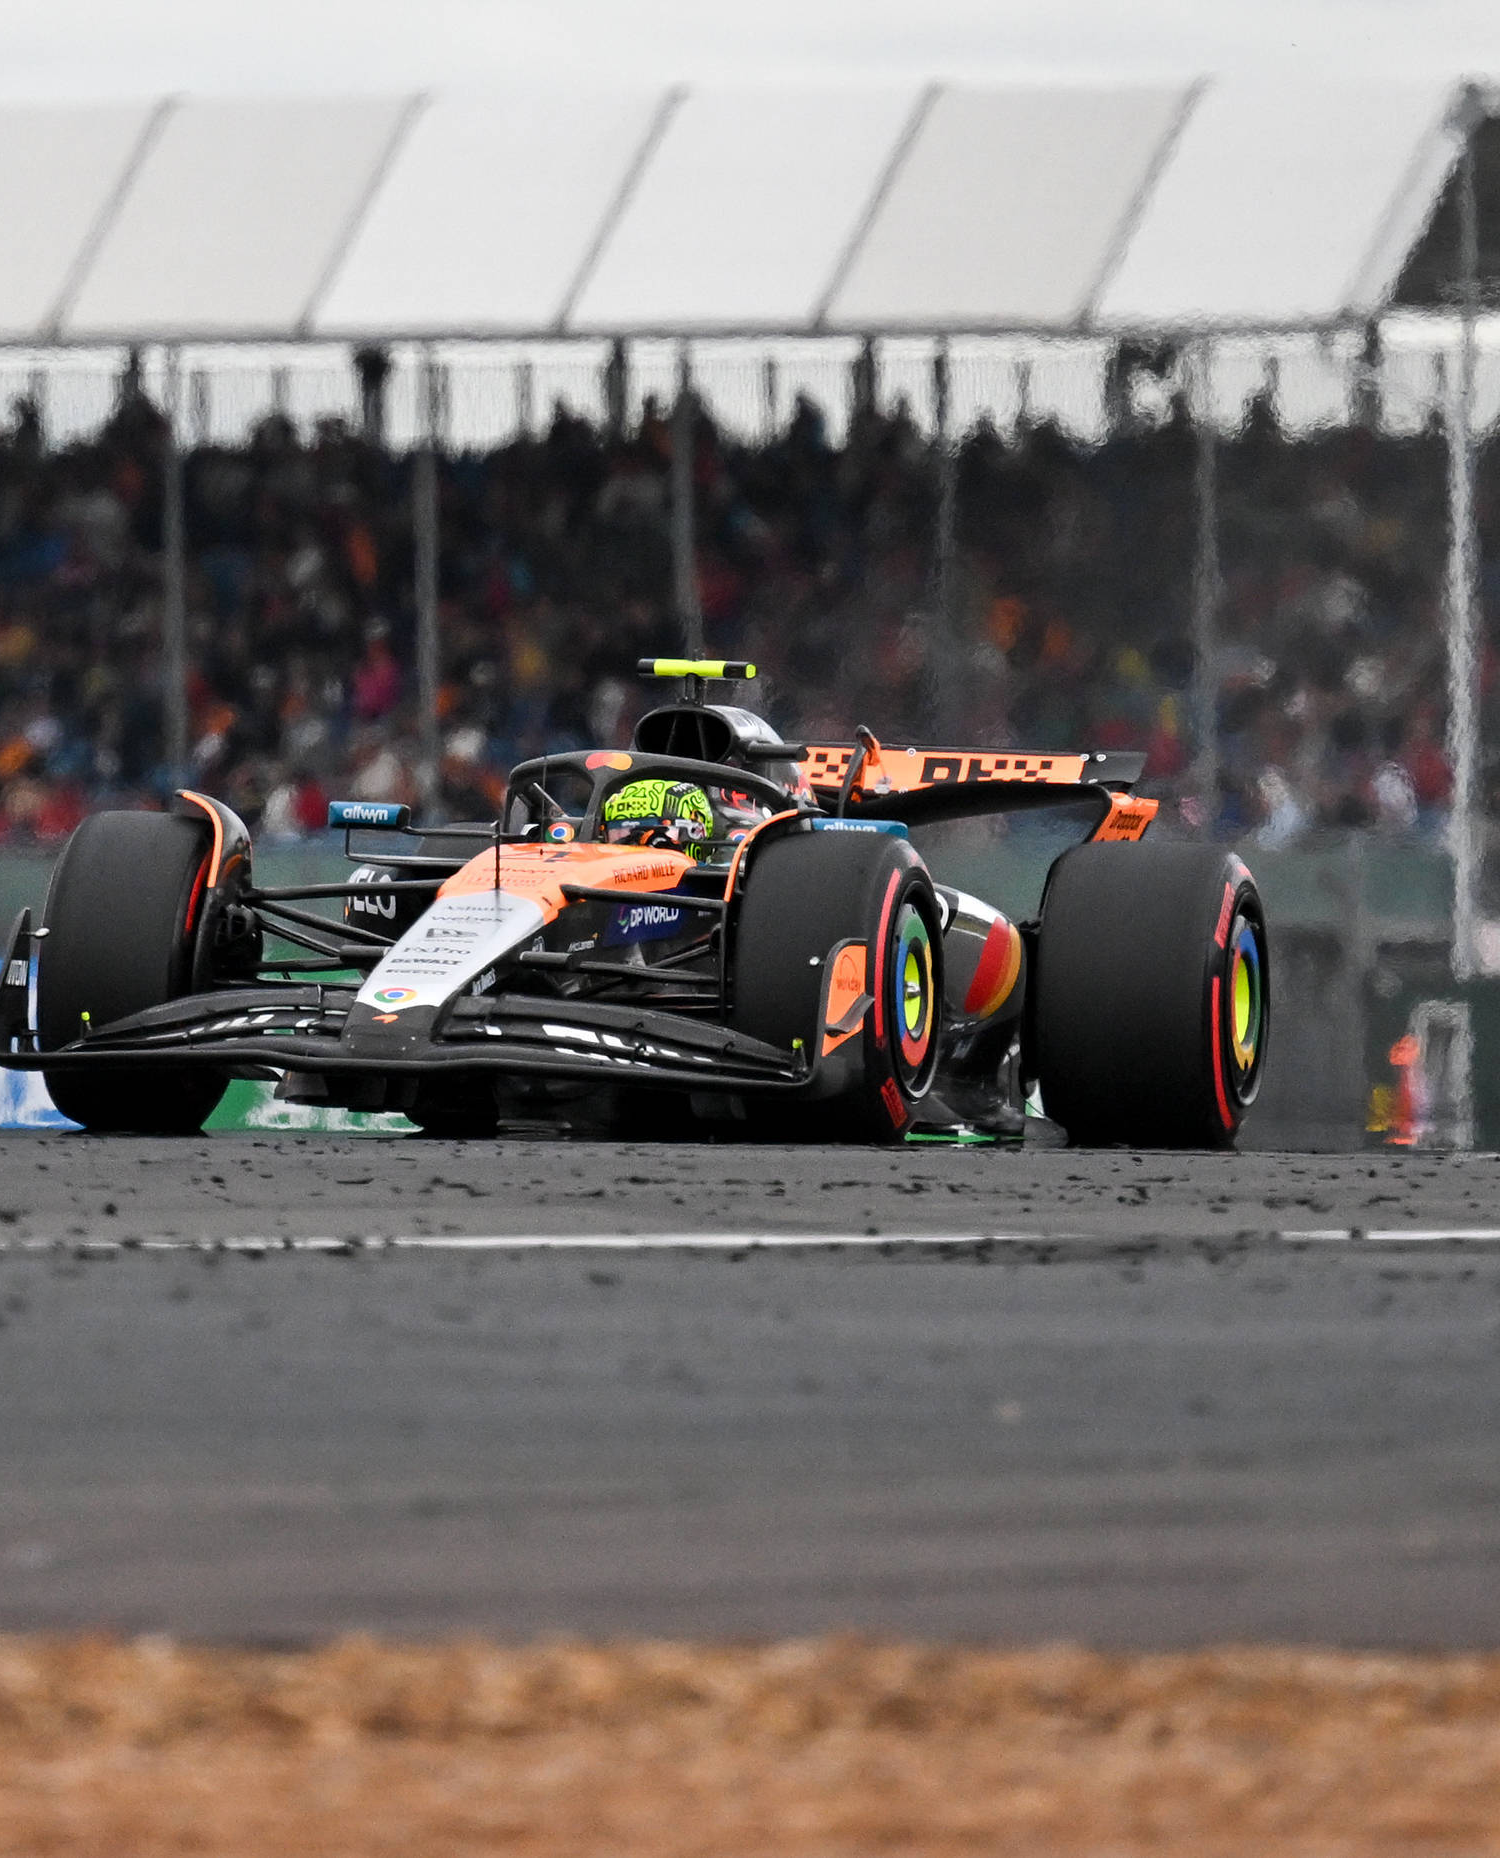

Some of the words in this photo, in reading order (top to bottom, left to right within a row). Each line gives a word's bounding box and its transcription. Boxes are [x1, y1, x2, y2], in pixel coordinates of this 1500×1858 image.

[342, 805, 389, 823] allwyn
[617, 801, 647, 813] OKX
[614, 864, 649, 885] RICHARD
[651, 860, 676, 879] MILLE
[629, 908, 643, 927] DP
[642, 906, 680, 925] WORLD
